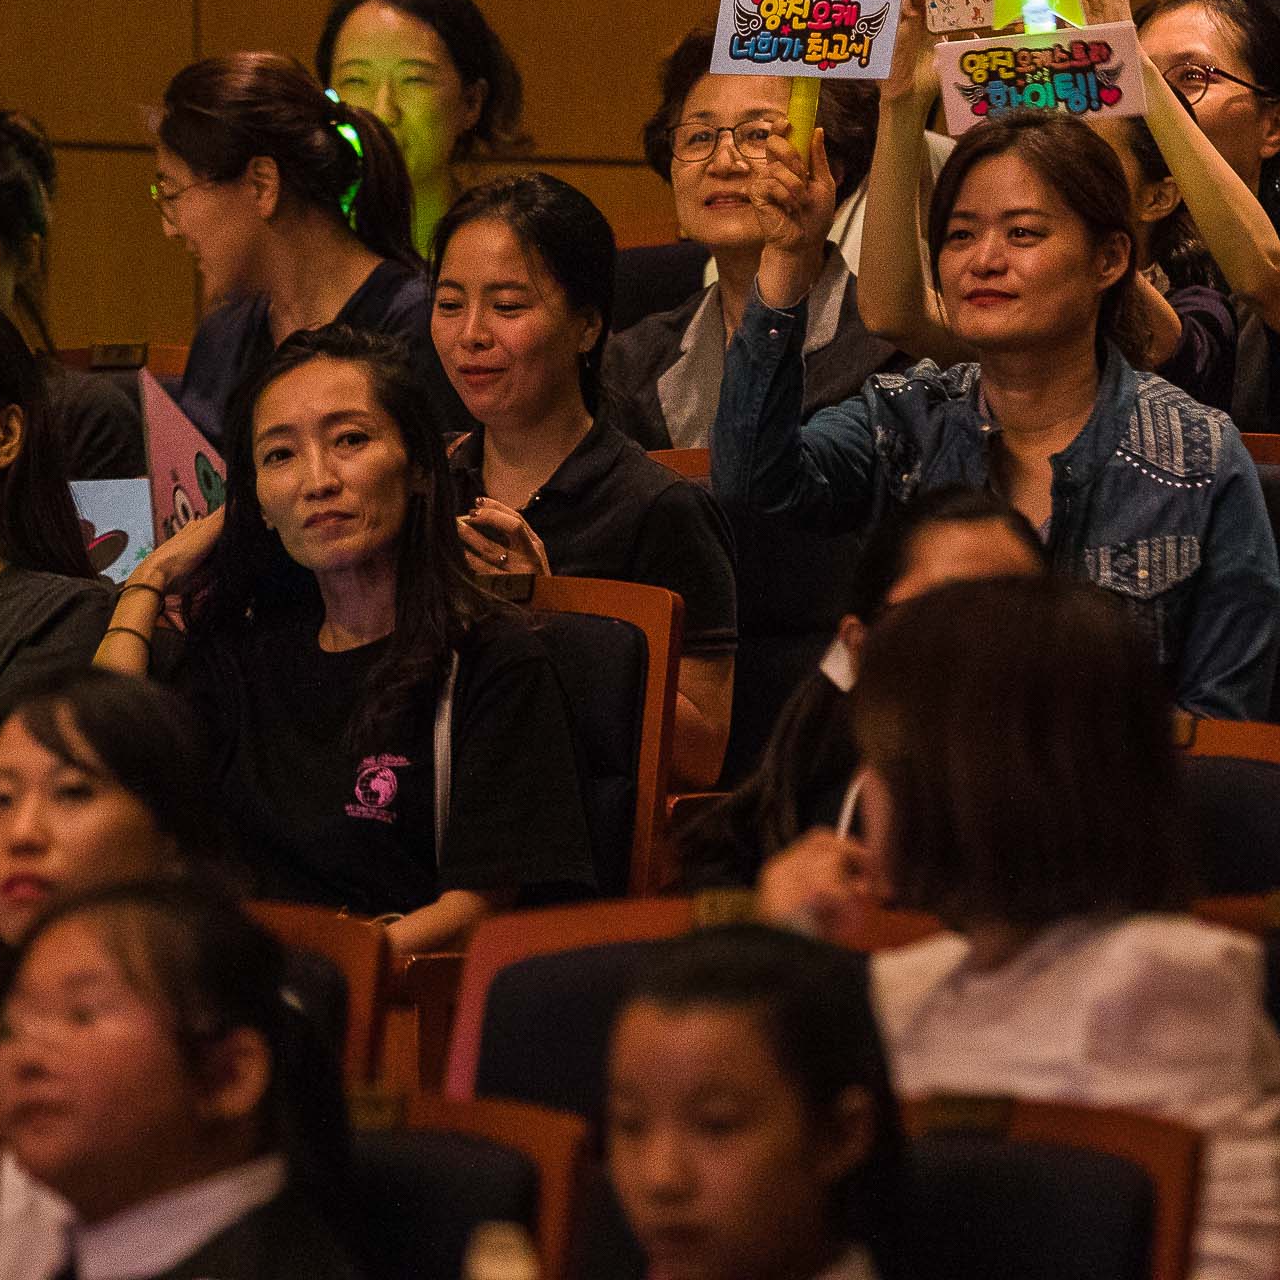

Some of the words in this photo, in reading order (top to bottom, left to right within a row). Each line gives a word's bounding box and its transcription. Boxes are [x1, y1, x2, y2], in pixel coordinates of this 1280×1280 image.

[807, 1, 858, 30] 오케
[732, 31, 803, 62] 너희가
[961, 50, 1015, 84] 양진
[1015, 41, 1112, 73] 오케스트라
